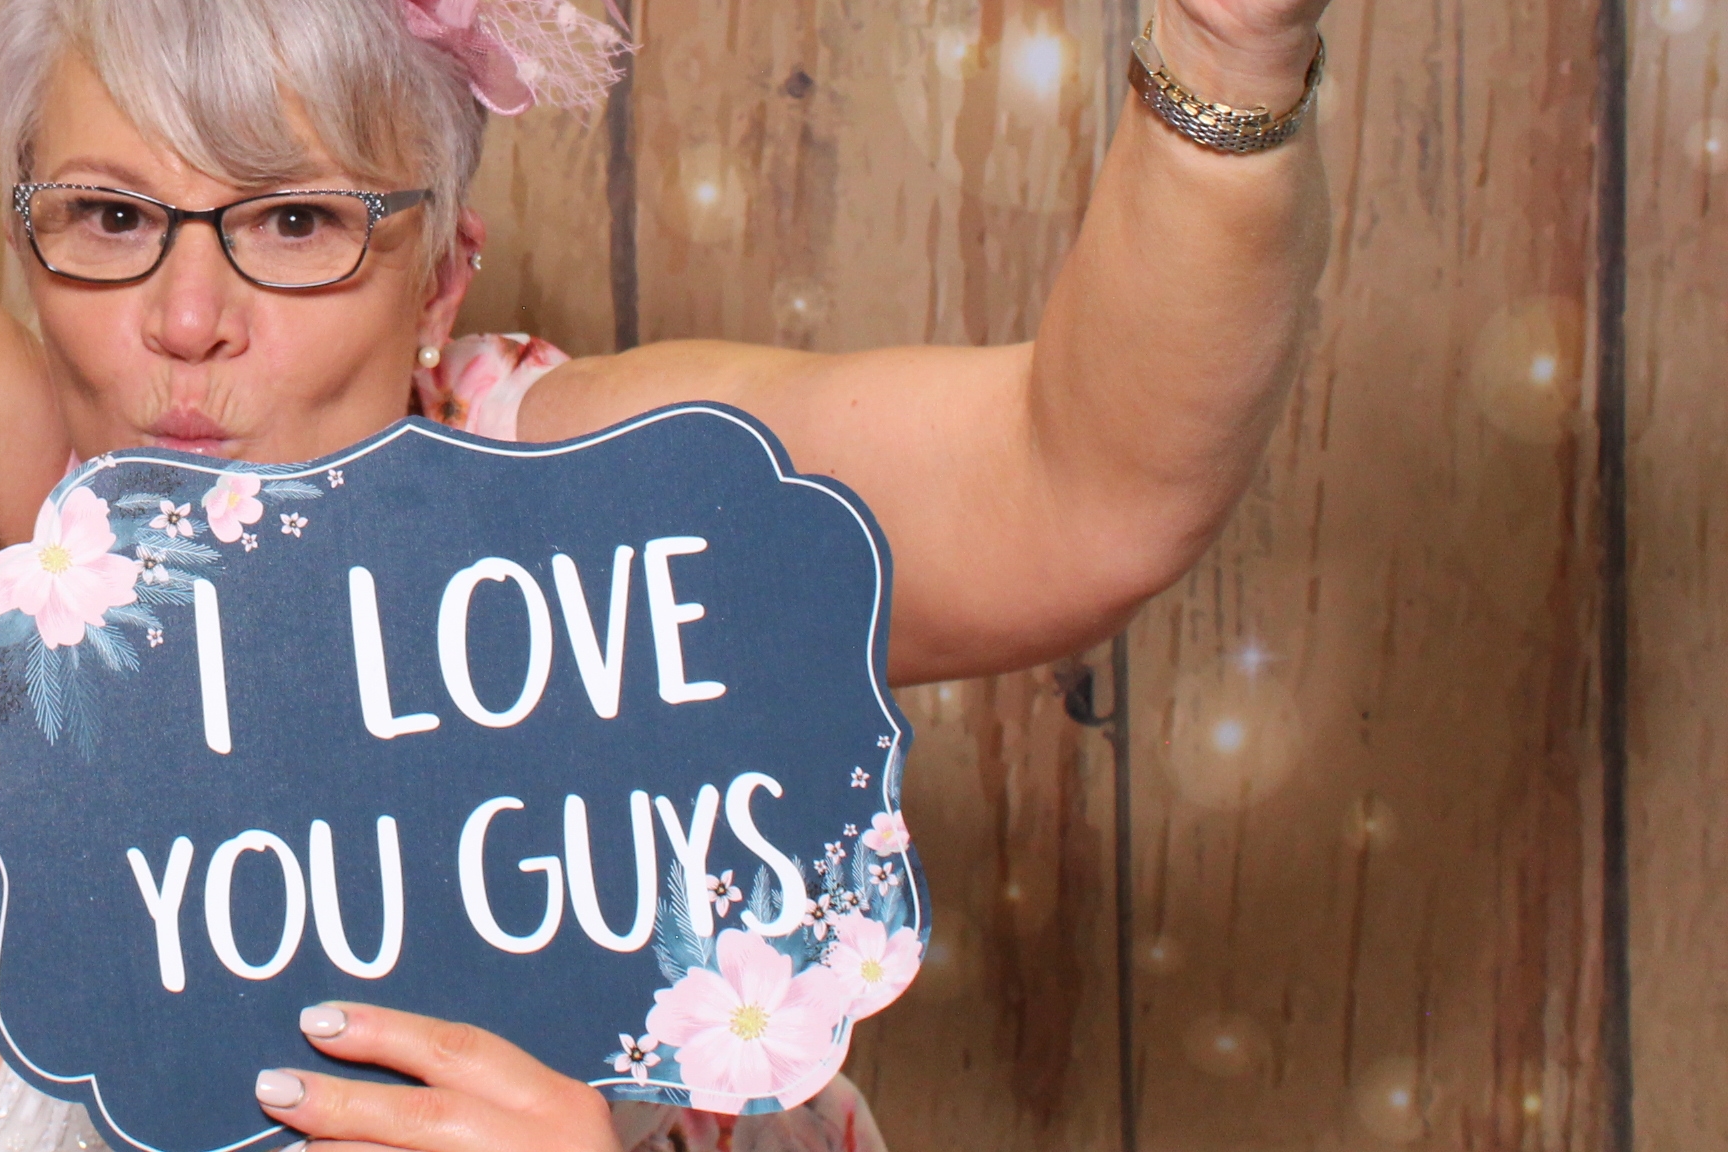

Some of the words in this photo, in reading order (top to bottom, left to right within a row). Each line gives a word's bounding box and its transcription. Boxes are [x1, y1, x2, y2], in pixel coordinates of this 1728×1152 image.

[193, 578, 232, 754] I
[348, 536, 727, 740] LOVE
[126, 814, 404, 993] YOU
[458, 772, 809, 954] GUYS
